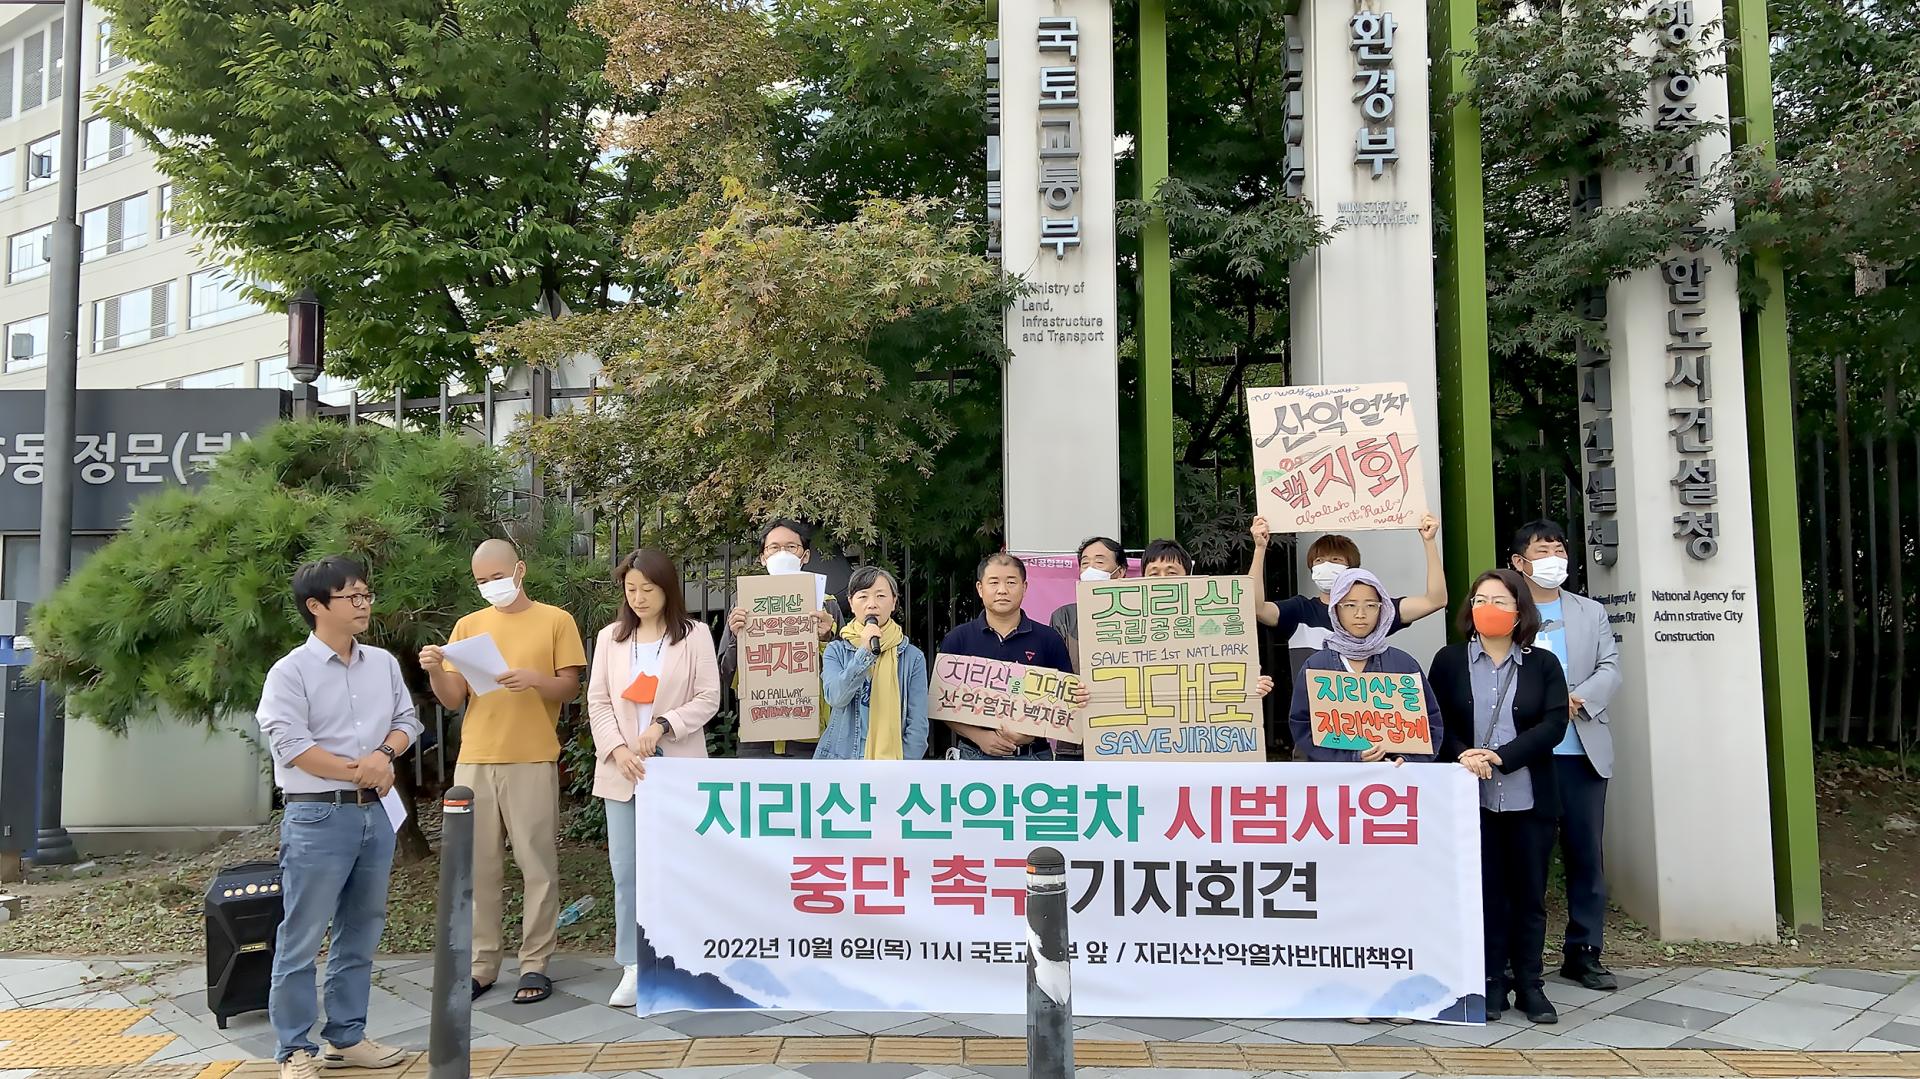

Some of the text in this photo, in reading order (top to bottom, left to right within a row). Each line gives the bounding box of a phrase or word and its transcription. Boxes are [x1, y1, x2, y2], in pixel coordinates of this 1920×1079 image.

[1349, 10, 1398, 180] 환경부
[1038, 16, 1080, 260] 국토교통부
[1338, 201, 1389, 213] MINISTRY
[1073, 281, 1085, 294] of
[1022, 299, 1054, 312] Land,
[1022, 315, 1103, 327] Infrastructure
[1022, 330, 1105, 344] and Transport
[1256, 393, 1410, 453] 산악열차
[0, 433, 45, 485] 동
[1271, 432, 1419, 512] 백지화
[753, 594, 803, 614] 지리산
[1092, 580, 1243, 619] 지리산
[1651, 589, 1746, 603] National Agency for
[746, 615, 816, 638] 산악열차
[1095, 616, 1195, 645] 국립공원
[1653, 610, 1744, 623] Admnstrative City
[1654, 631, 1715, 642] Construction
[745, 641, 816, 677] 백지화
[1090, 651, 1129, 667] SAVE
[1133, 649, 1157, 663] THE
[1186, 644, 1219, 659] NAT'L
[1220, 643, 1249, 656] PARK
[751, 688, 804, 700] NO RAILWAY
[1023, 671, 1080, 705] 그대로
[1089, 662, 1253, 728] 그대로
[1314, 675, 1421, 712] 지리산을
[938, 689, 1075, 728] 산악열차 백지화
[1095, 725, 1258, 755] SAVE JIRISAN
[1315, 709, 1429, 743] 지리산답게
[695, 781, 1419, 846] 지리산 산악열차 시범사업
[790, 854, 1319, 920] 중단 촉구 기자회견
[703, 937, 780, 959] 2022년
[787, 937, 834, 959] 10월
[841, 937, 912, 961] 6일(목)
[919, 941, 963, 962] 11시
[970, 941, 1079, 965] 국토교부
[1086, 941, 1109, 964] 앞
[1133, 941, 1415, 971] 지리산산악열차반대대책위
